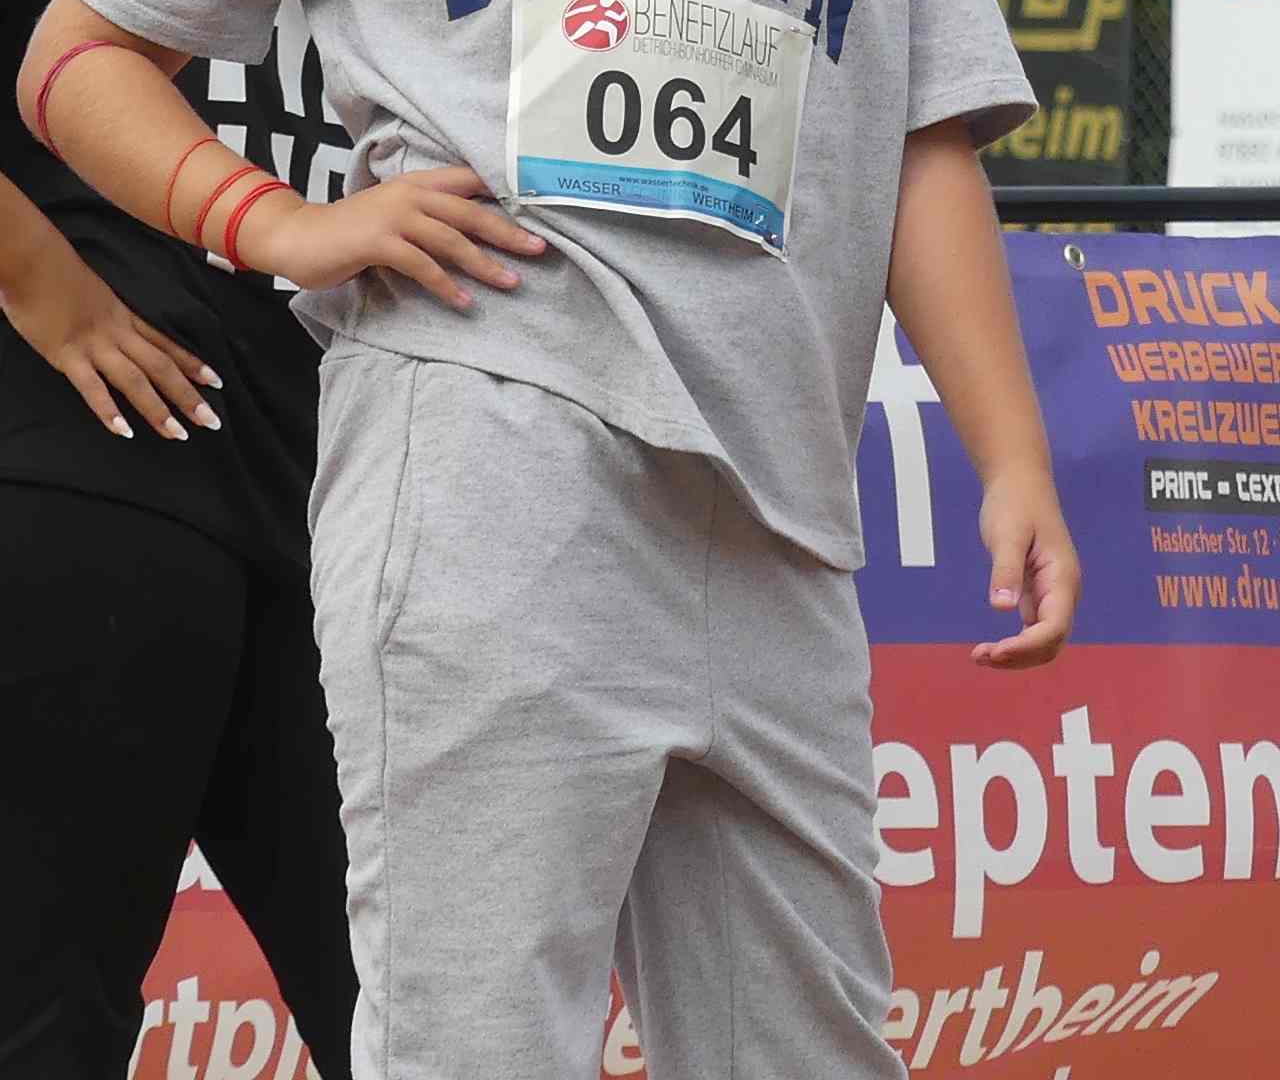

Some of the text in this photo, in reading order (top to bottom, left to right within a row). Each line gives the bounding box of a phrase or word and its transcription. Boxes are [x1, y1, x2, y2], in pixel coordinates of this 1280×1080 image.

[586, 70, 758, 178] 064
[556, 177, 621, 196] WASSER
[692, 191, 754, 225] WERTHEIM
[1151, 470, 1212, 500] PRINT
[1151, 526, 1223, 554] Haslocher
[1227, 528, 1250, 554] Str.
[1253, 530, 1270, 556] 12
[880, 949, 1220, 1071] ertheim
